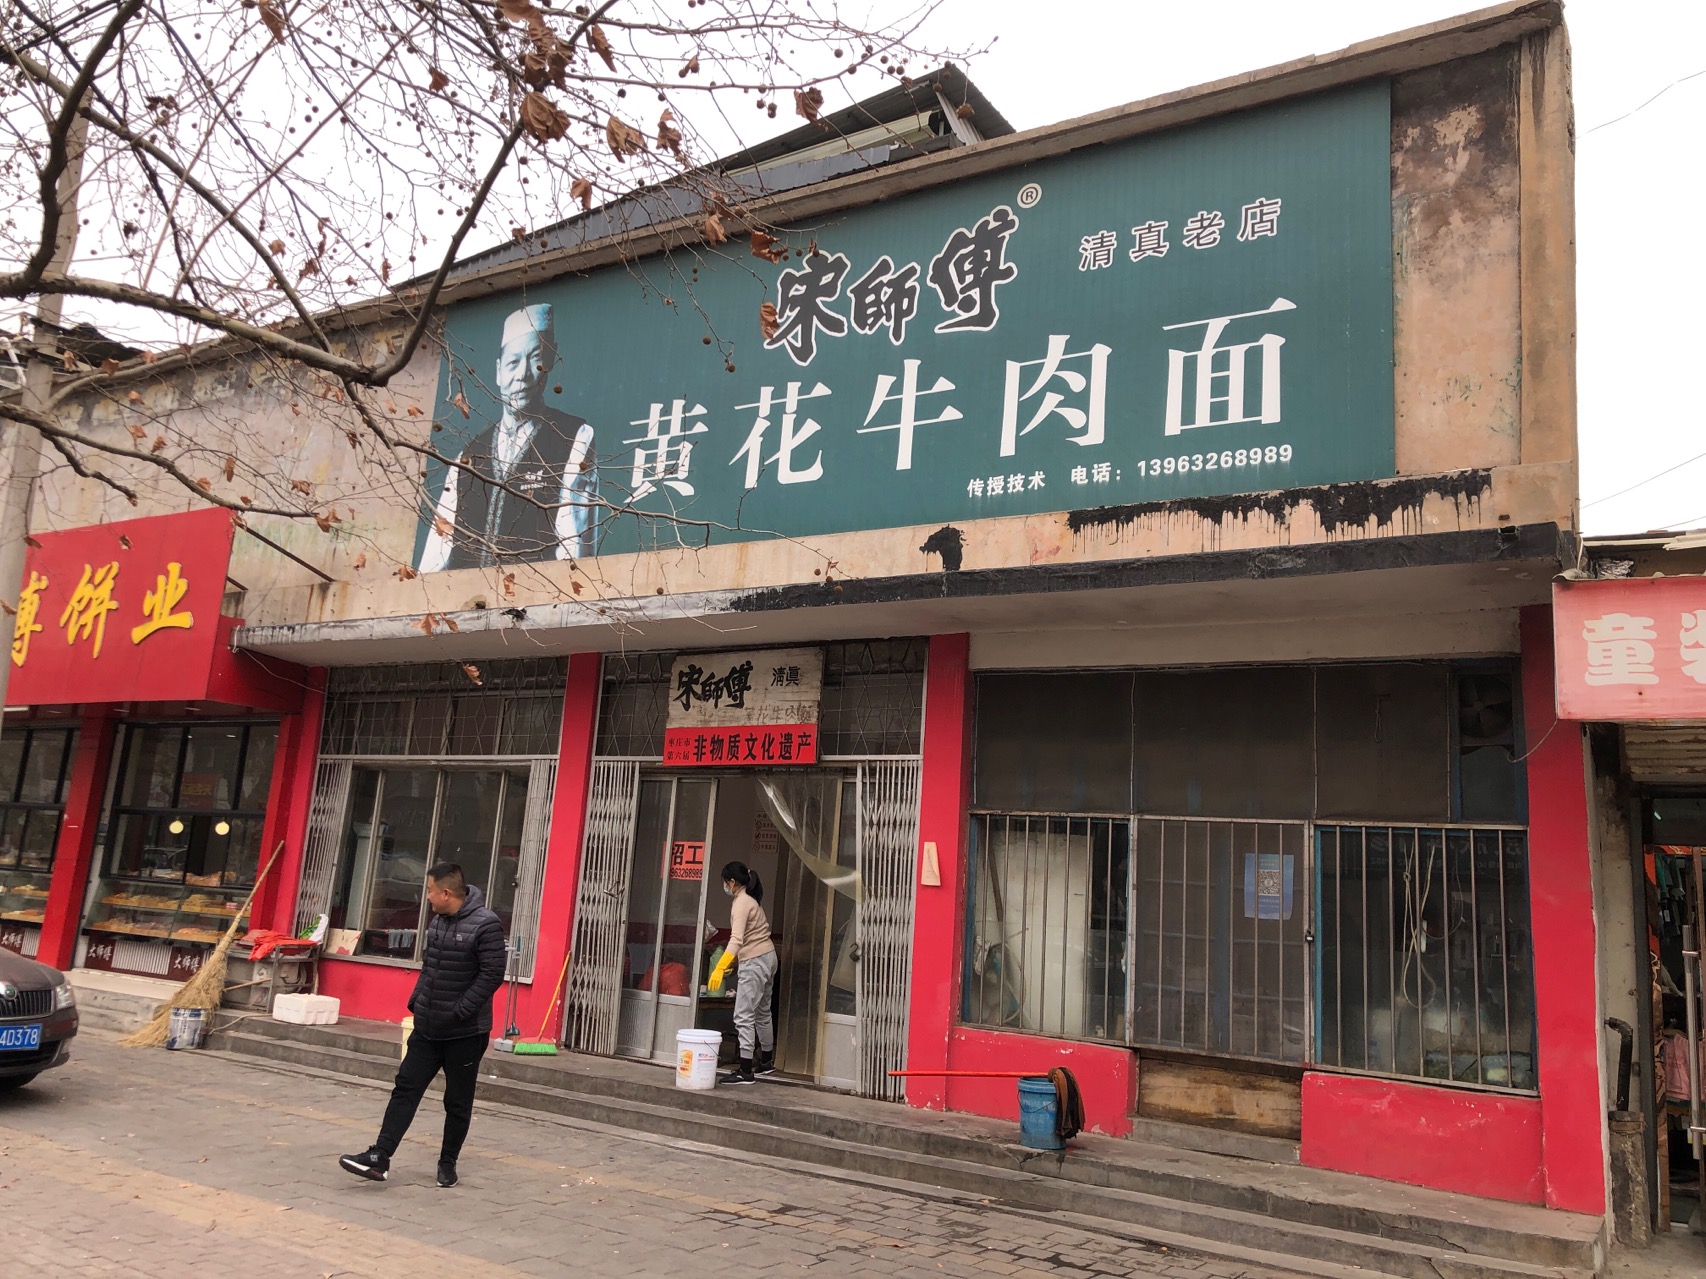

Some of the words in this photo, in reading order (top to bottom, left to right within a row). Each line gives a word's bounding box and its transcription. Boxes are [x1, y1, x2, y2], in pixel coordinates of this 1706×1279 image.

[1079, 197, 1282, 272] 清真老店
[620, 297, 1298, 503] 黄花牛肉面
[967, 472, 1047, 499] 传授技术
[1137, 444, 1293, 477] 13963268989
[693, 731, 812, 762] 非物质文化遗产
